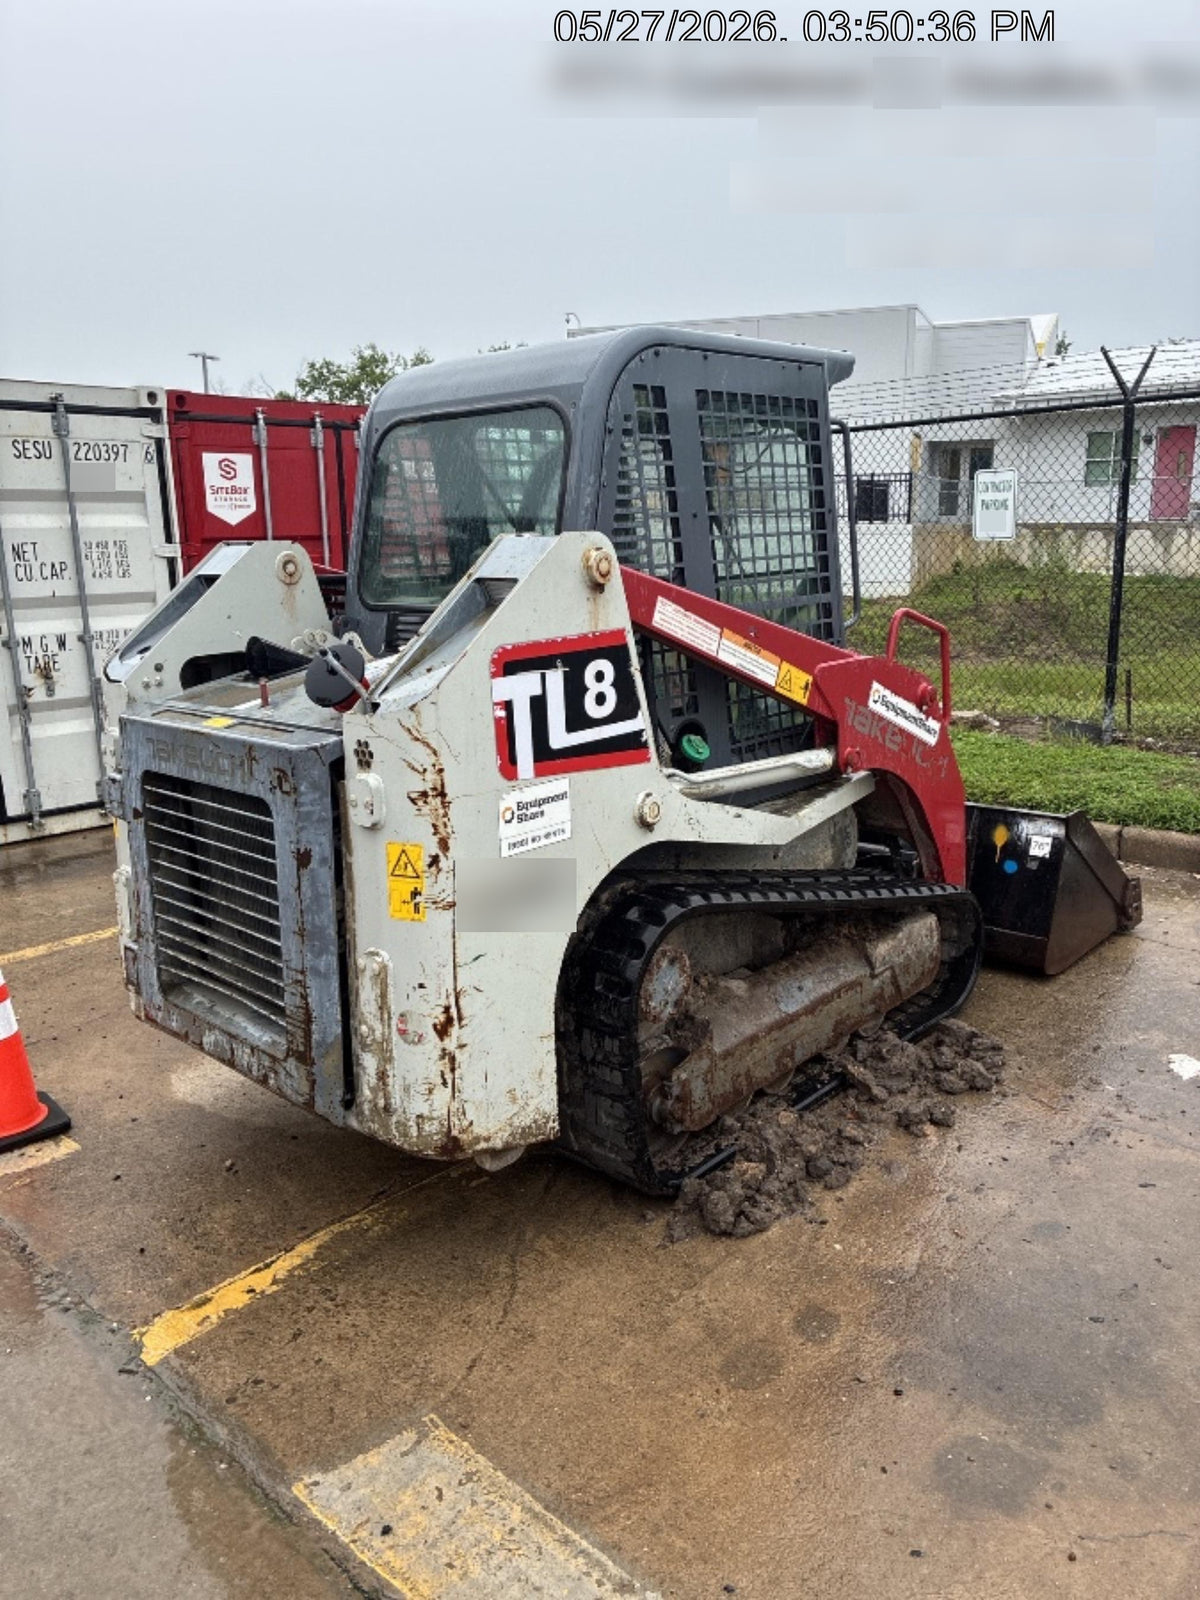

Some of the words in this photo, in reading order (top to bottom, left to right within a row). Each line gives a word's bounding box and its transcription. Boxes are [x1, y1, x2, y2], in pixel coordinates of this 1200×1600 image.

[11, 438, 53, 460] SESU
[72, 441, 129, 463] 220397
[11, 541, 38, 562] NET
[516, 791, 568, 812] Equipment
[516, 809, 545, 824] Share
